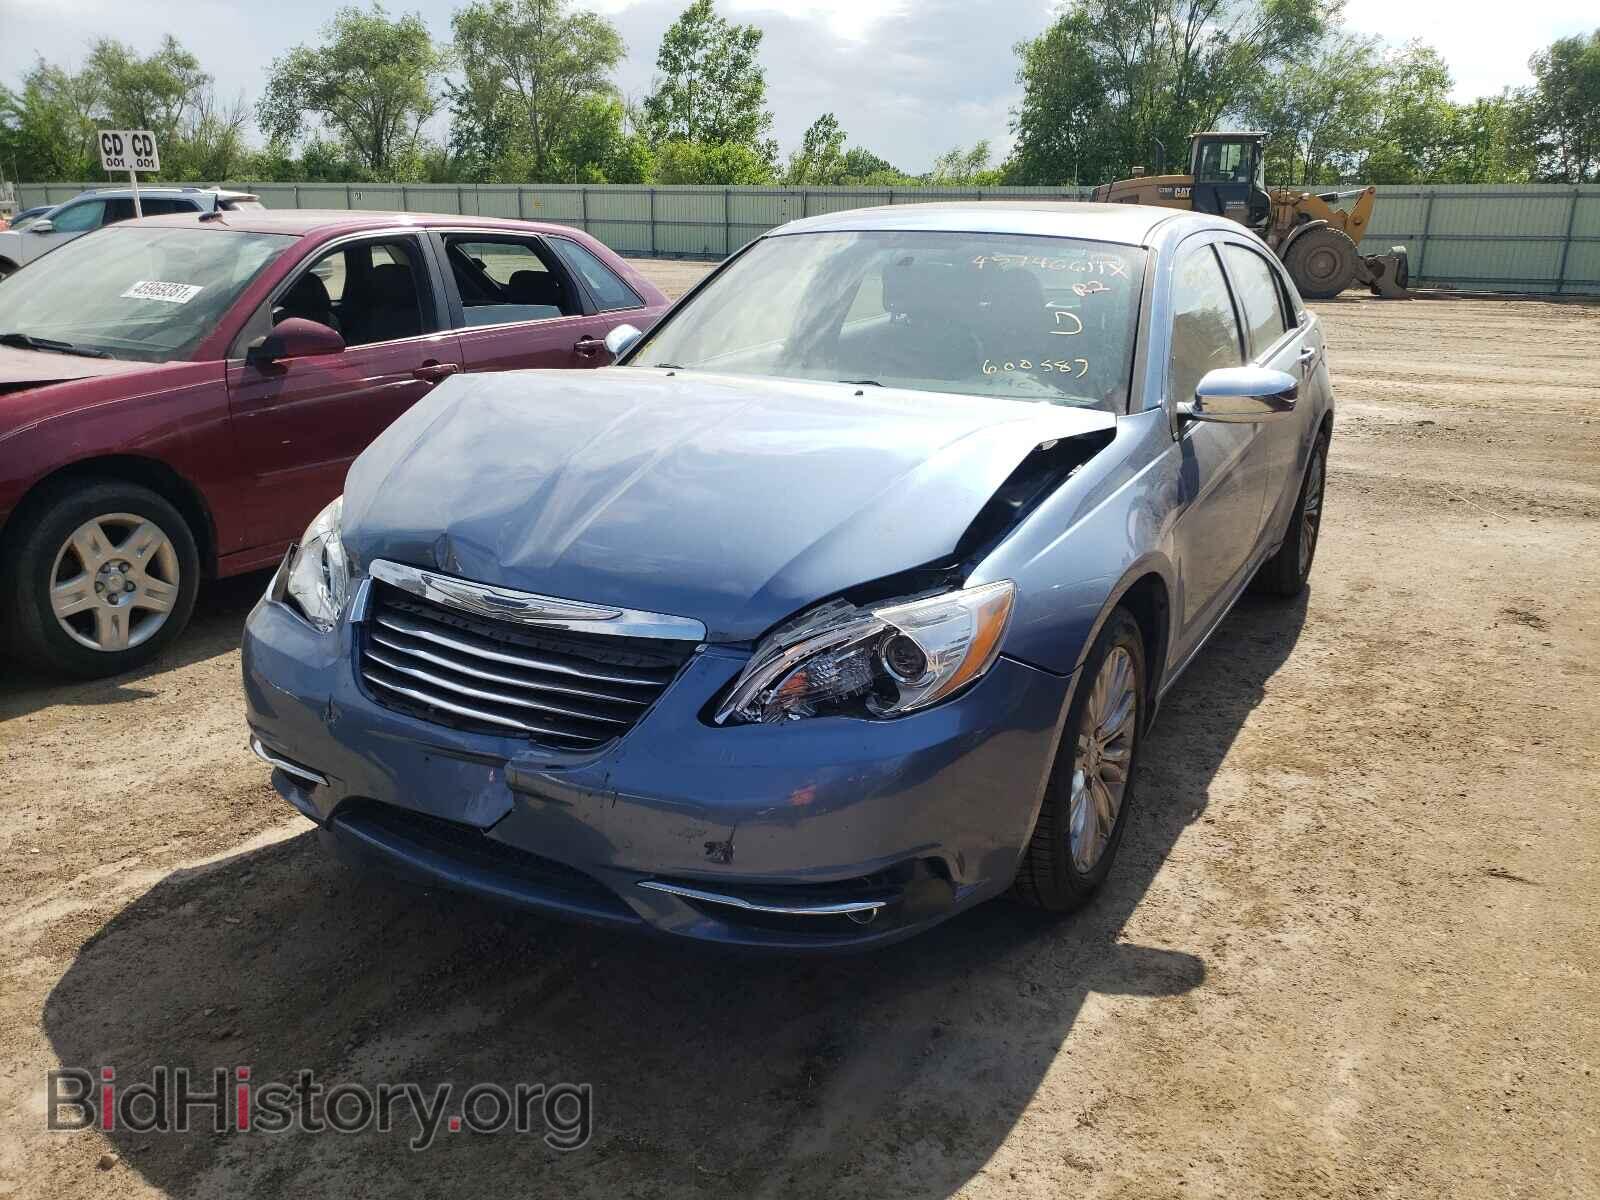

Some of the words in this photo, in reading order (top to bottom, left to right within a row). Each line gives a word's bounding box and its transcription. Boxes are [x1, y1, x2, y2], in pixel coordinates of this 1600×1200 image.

[102, 133, 123, 156] CD
[132, 134, 153, 157] CD
[106, 157, 125, 167] 001
[137, 158, 155, 168] 001
[1174, 187, 1191, 198] CAT
[1049, 311, 1082, 334] D
